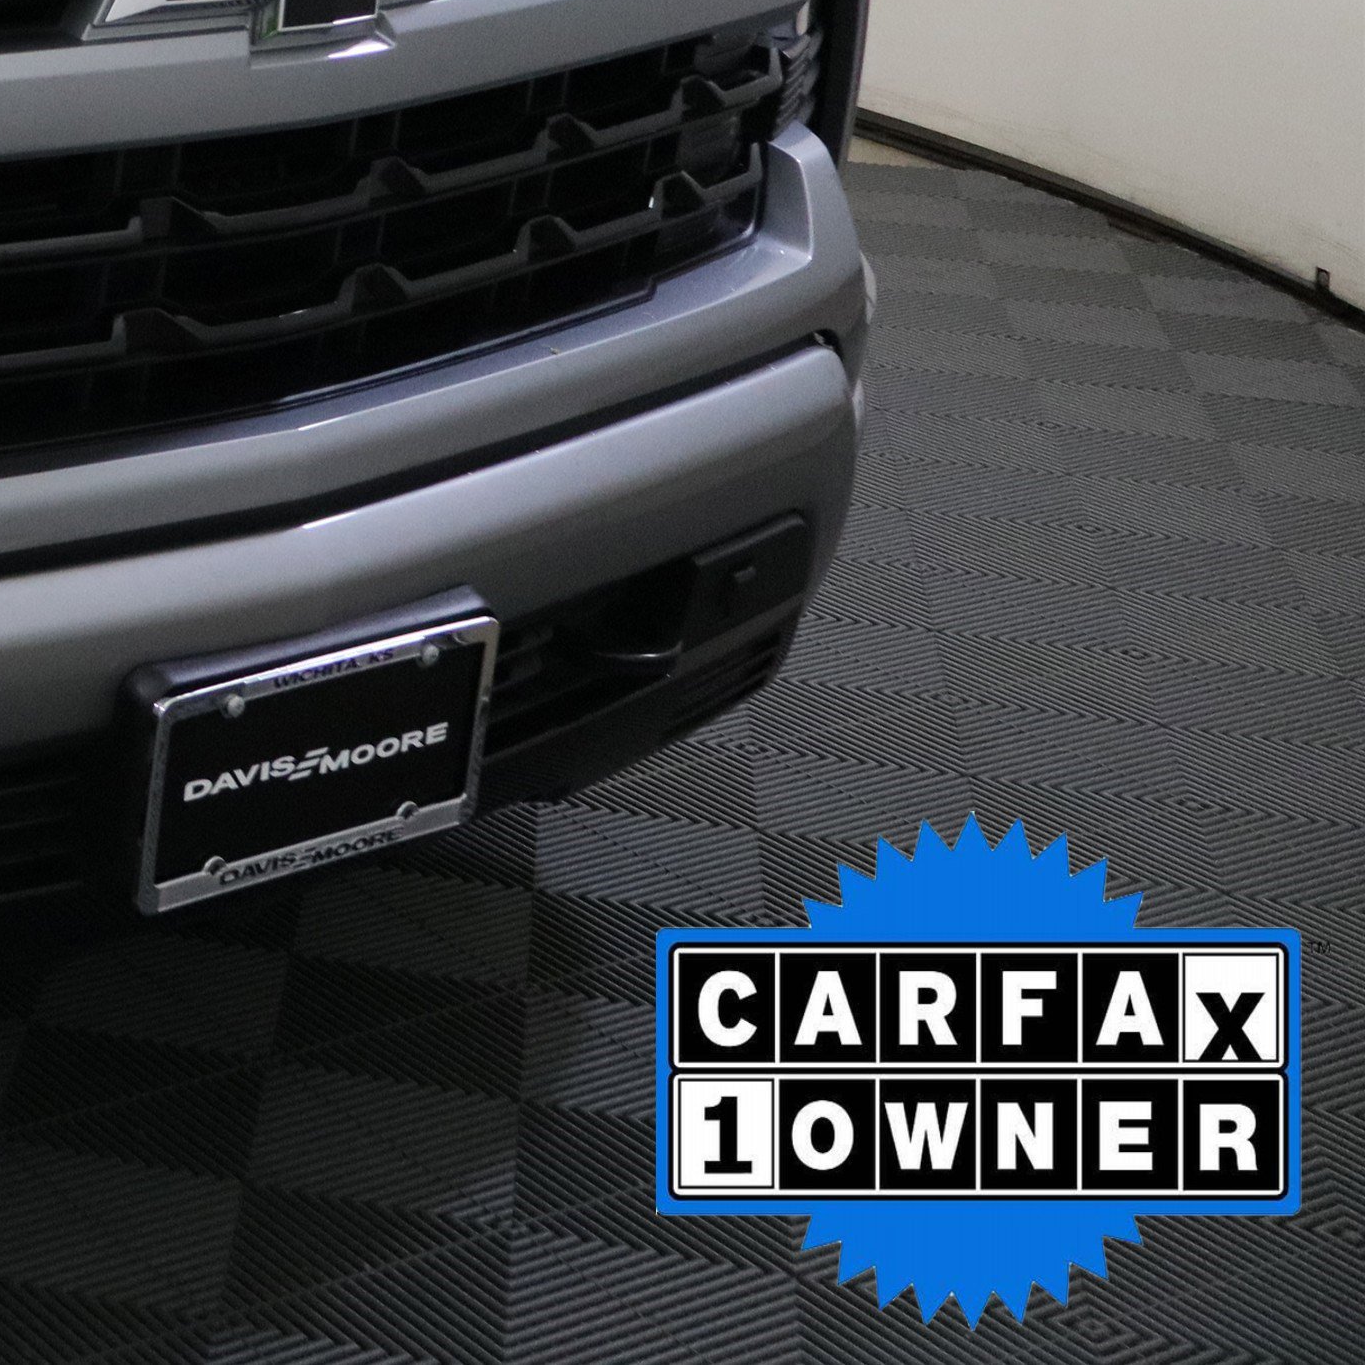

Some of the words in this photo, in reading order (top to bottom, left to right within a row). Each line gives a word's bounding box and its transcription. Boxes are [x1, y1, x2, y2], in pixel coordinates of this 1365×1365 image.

[183, 755, 301, 802] DAVIS
[318, 721, 449, 775] MOORE
[219, 852, 297, 885] DAVIS
[310, 826, 405, 864] MOORE
